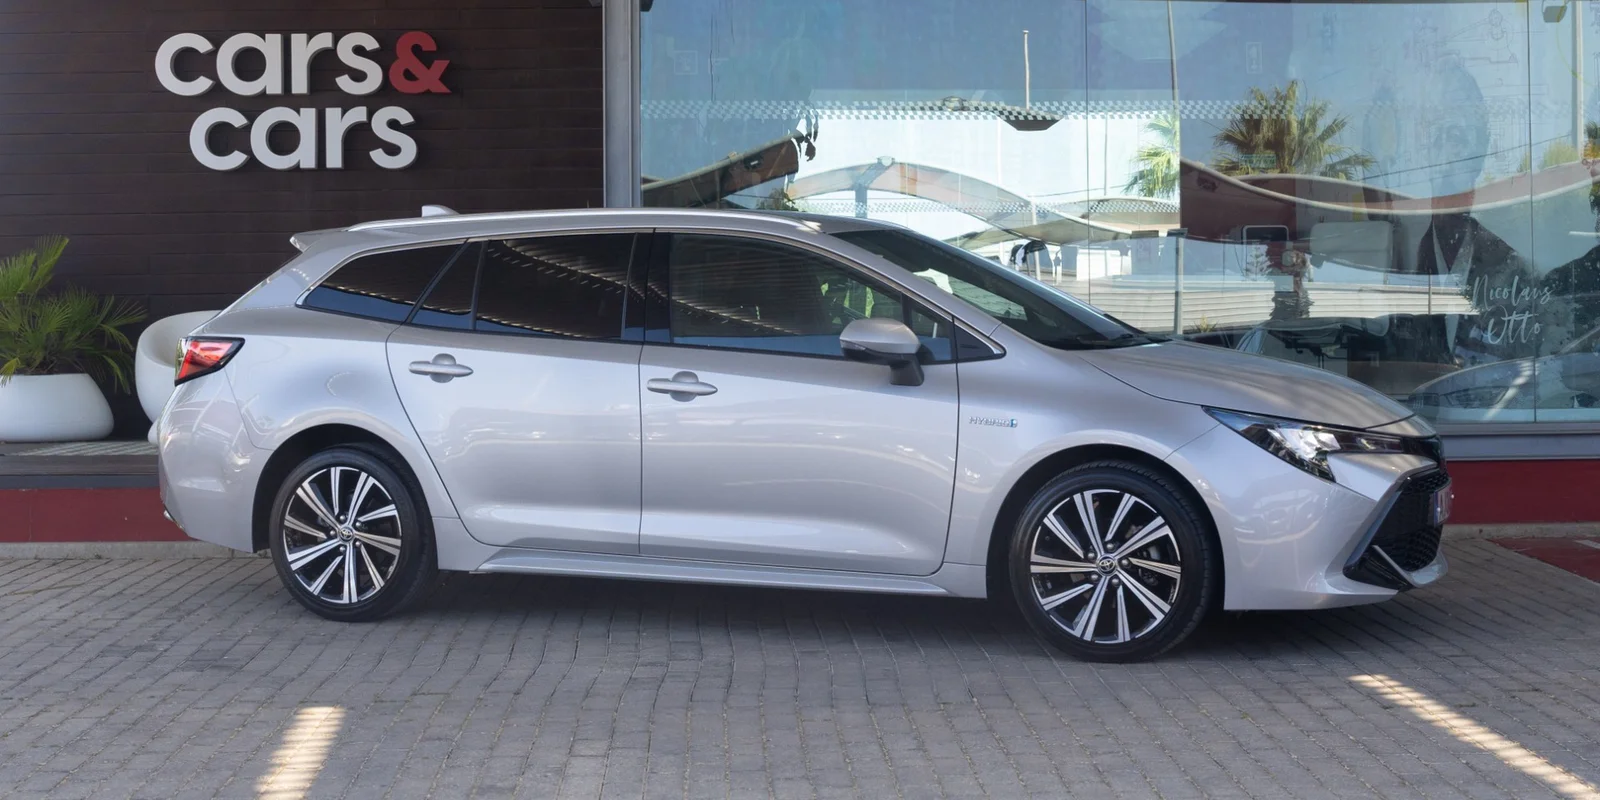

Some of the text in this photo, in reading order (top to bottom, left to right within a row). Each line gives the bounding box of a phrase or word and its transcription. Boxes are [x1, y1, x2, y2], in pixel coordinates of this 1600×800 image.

[189, 105, 418, 171] cars
[1472, 274, 1554, 312] Nicolaus
[1483, 305, 1544, 344] Otto
